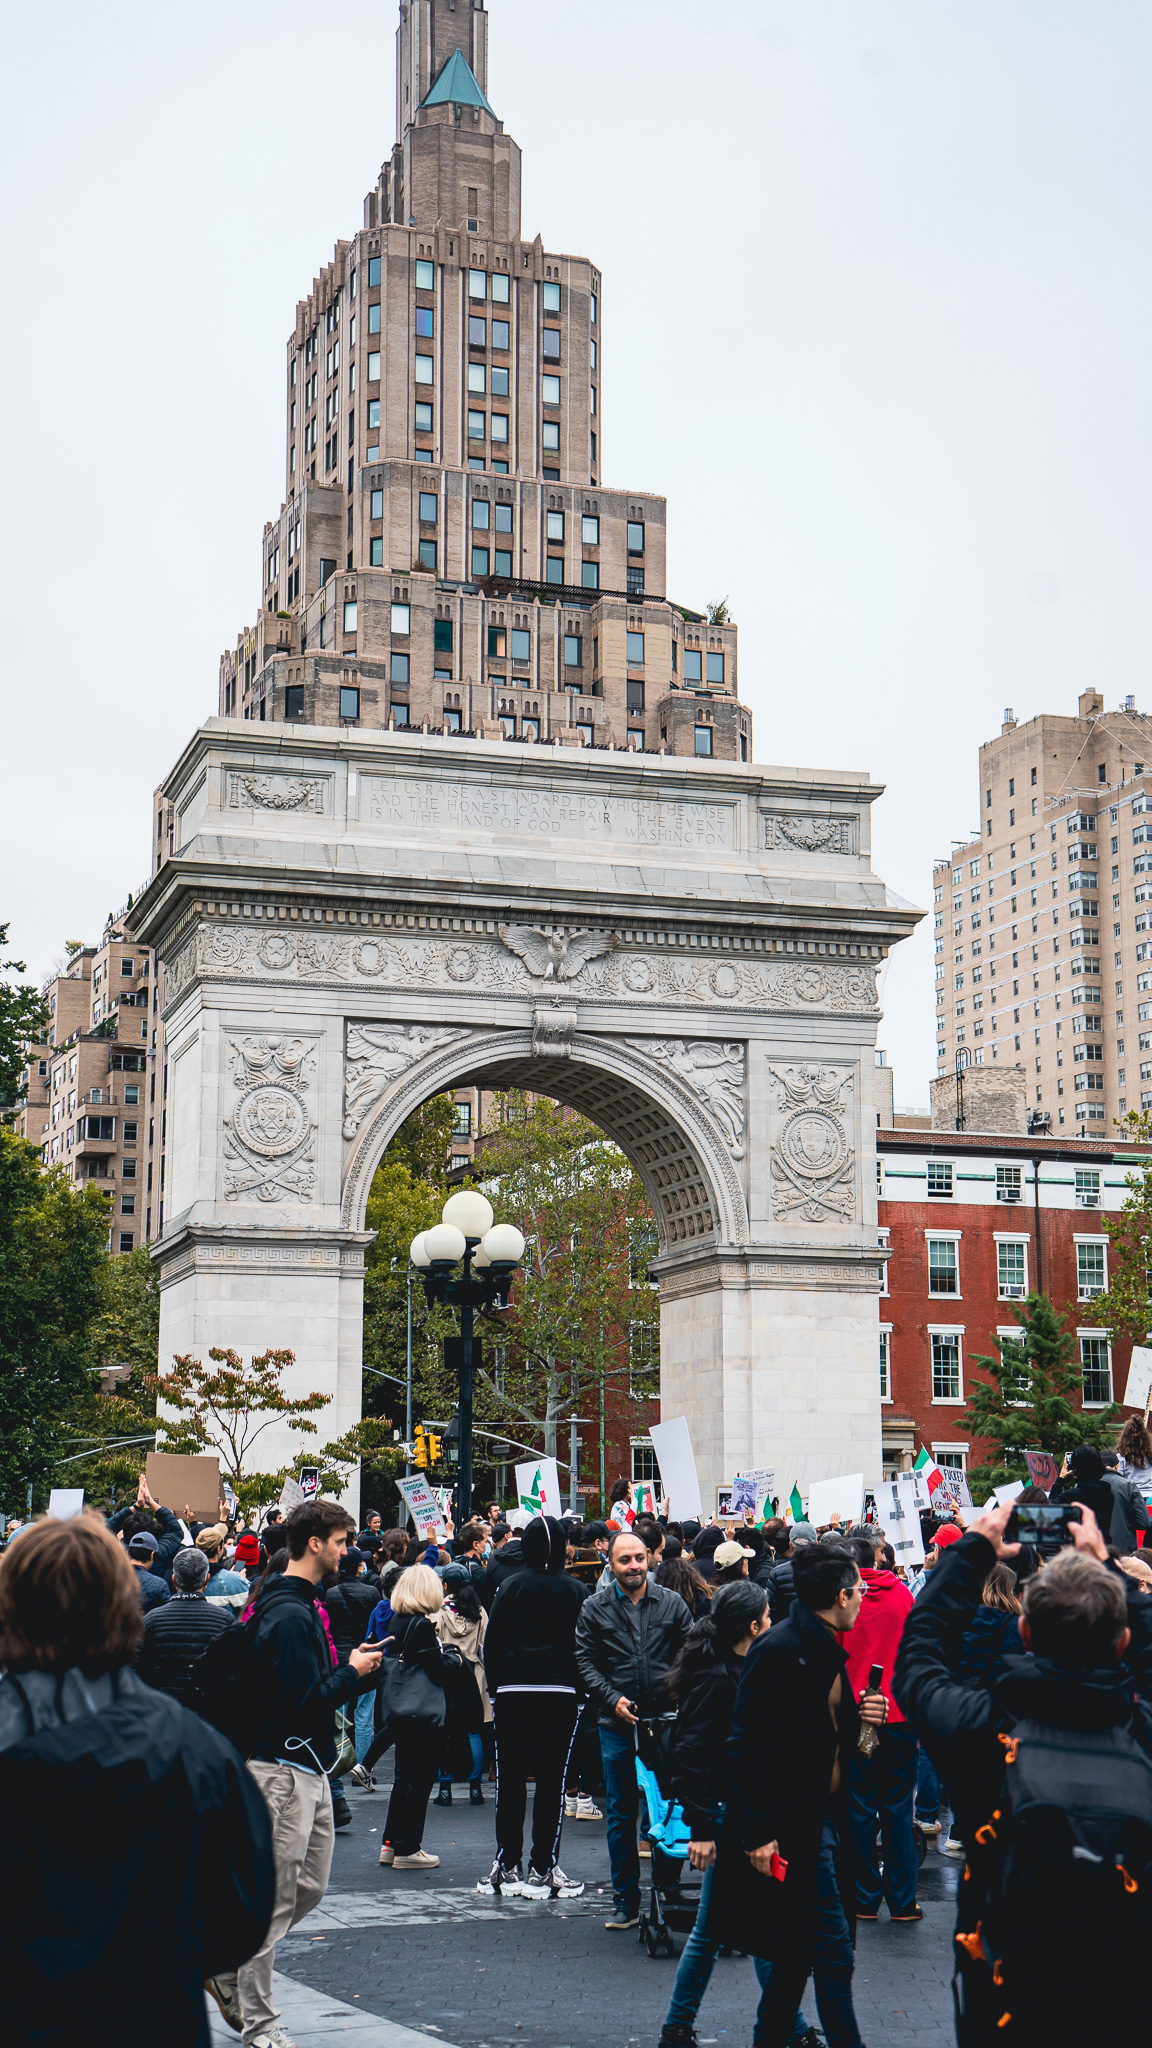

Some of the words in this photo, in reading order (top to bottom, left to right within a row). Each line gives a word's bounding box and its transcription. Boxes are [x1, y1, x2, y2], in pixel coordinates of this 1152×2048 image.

[371, 780, 399, 793] LET
[404, 782, 420, 794] US
[426, 784, 469, 799] RAISE
[474, 789, 485, 800] A
[491, 789, 571, 807] STANDARD
[577, 797, 597, 809] TO
[602, 798, 651, 814] WHICH
[656, 803, 685, 817] THE
[690, 805, 725, 820] WISE
[370, 794, 401, 807] AND
[407, 796, 438, 810] THE
[447, 799, 510, 815] HONEST
[519, 805, 551, 818] CAN
[559, 808, 611, 824] REPAIR
[636, 813, 666, 828] THE
[675, 817, 726, 832] EVENT
[370, 806, 382, 819] IS
[389, 808, 403, 820] IN
[410, 809, 441, 823] THE
[449, 813, 494, 828] HAND
[500, 818, 521, 829] OF
[528, 819, 561, 833] GOD
[624, 826, 726, 845] WASHINGTON
[943, 1469, 964, 1482] FUCKED
[403, 1482, 424, 1491] FREEDOM
[949, 1483, 961, 1494] THE
[412, 1494, 427, 1503] IRAN
[415, 1506, 436, 1516] WOMAN
